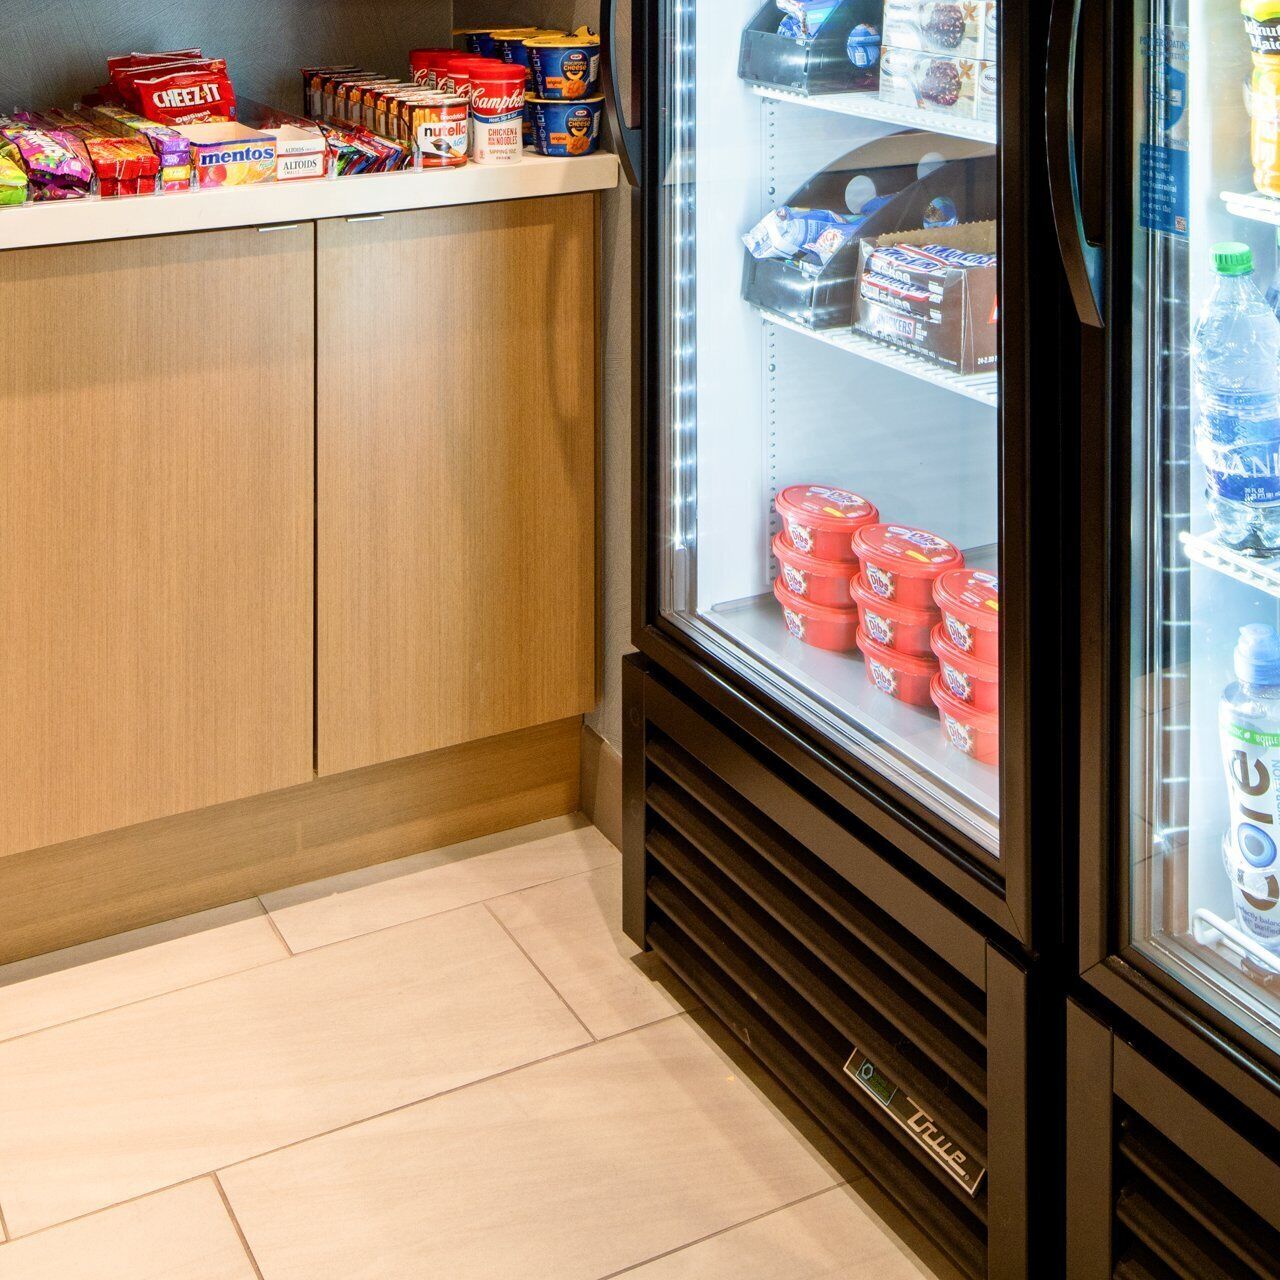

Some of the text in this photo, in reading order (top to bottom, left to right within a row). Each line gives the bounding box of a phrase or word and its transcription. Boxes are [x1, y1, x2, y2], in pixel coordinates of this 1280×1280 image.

[424, 122, 468, 138] nutella
[200, 147, 275, 165] mentos
[282, 158, 317, 171] ALTOIDS
[792, 530, 810, 546] Dibs
[786, 575, 803, 589] Dibs
[870, 573, 889, 591] Dibs
[870, 619, 888, 637] Dibs
[949, 623, 968, 644] Dibs
[1231, 749, 1280, 912] core
[906, 1096, 967, 1176] true
